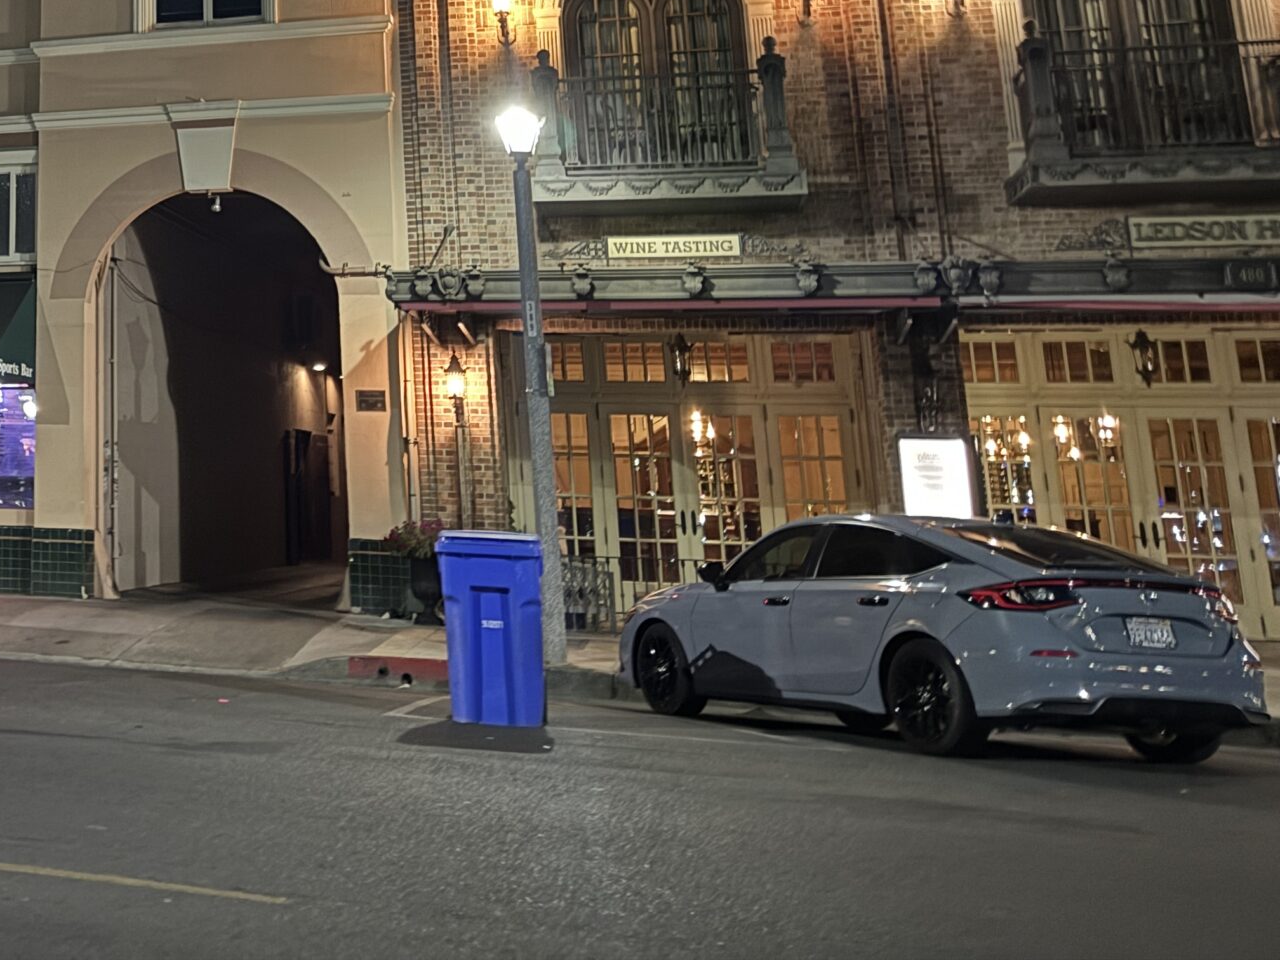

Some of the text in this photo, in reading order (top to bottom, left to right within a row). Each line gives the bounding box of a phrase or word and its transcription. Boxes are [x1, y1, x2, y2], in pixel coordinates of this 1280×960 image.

[1133, 218, 1250, 242] LEDSON
[613, 239, 734, 255] WINE TASTING
[20, 362, 34, 378] Bar
